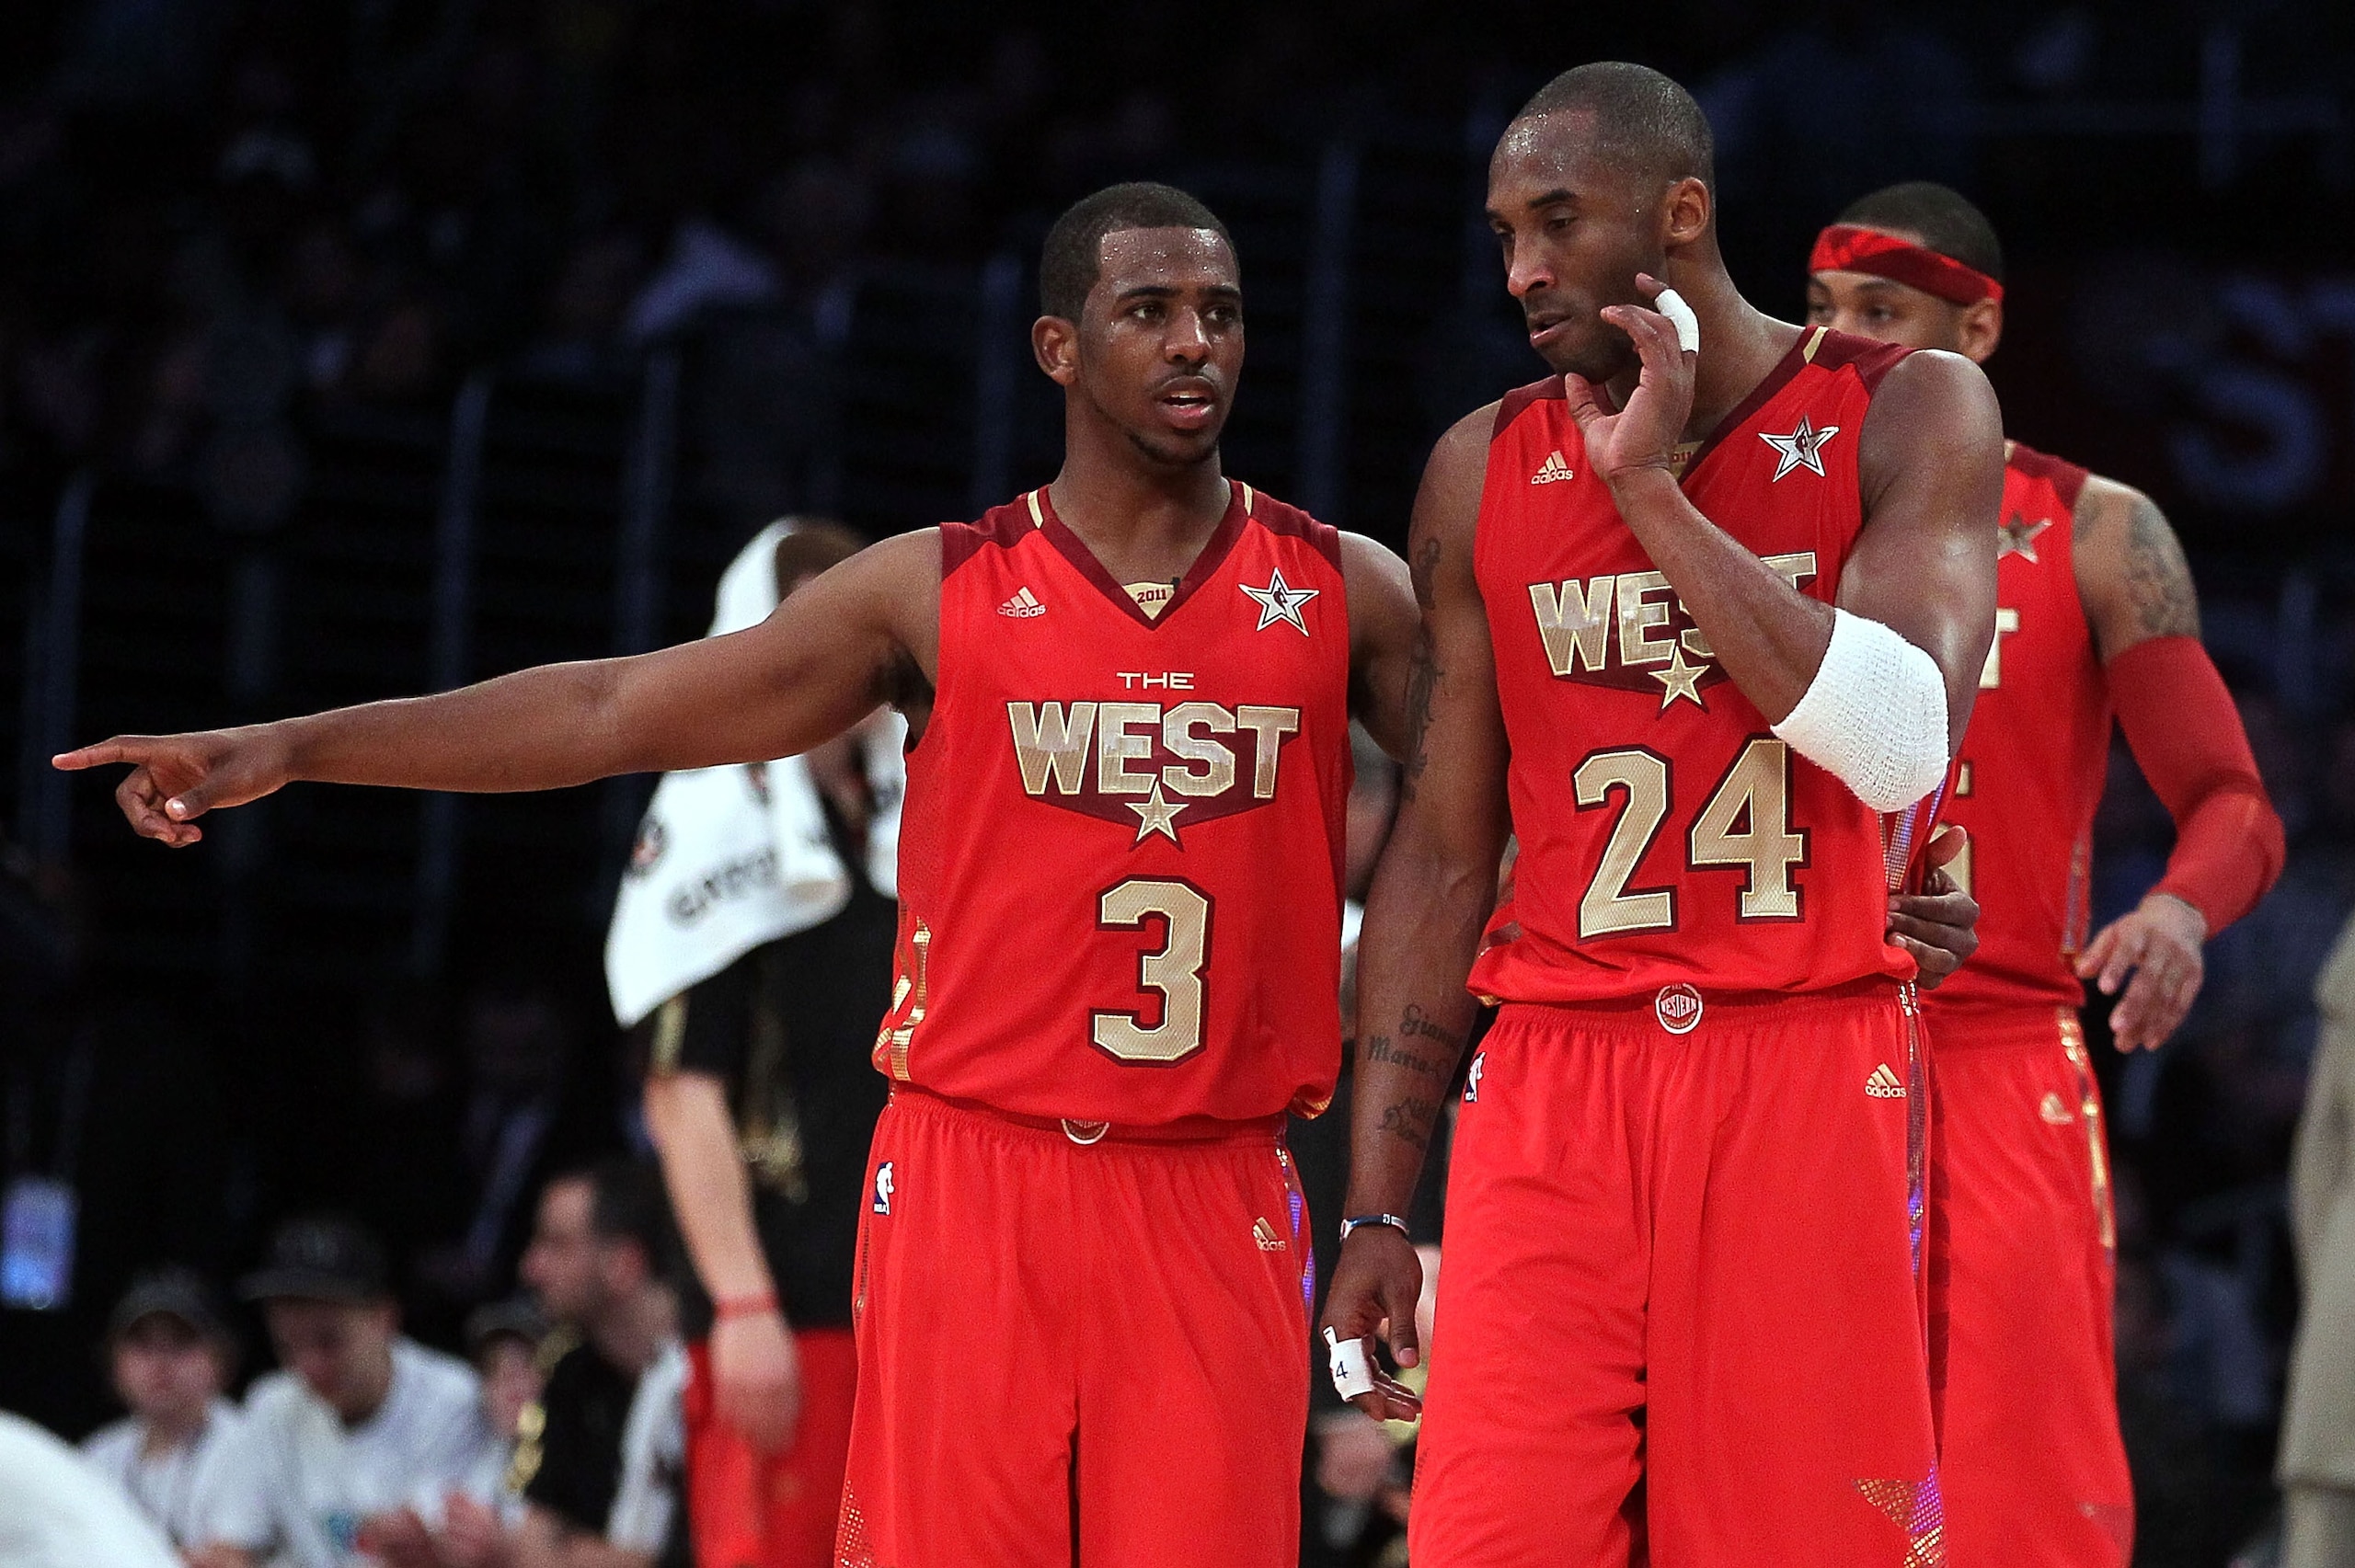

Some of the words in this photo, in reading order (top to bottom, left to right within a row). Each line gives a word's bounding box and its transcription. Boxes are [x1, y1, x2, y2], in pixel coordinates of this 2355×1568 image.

[1531, 469, 1574, 484] adidas
[1137, 589, 1167, 604] 2011
[996, 604, 1047, 618] adidas
[1116, 671, 1195, 691] THE
[1007, 701, 1300, 799] WEST
[1573, 738, 1803, 938] 24
[1092, 878, 1210, 1062] 3
[1865, 1084, 1907, 1098] adidas
[1335, 1360, 1349, 1379] 4
